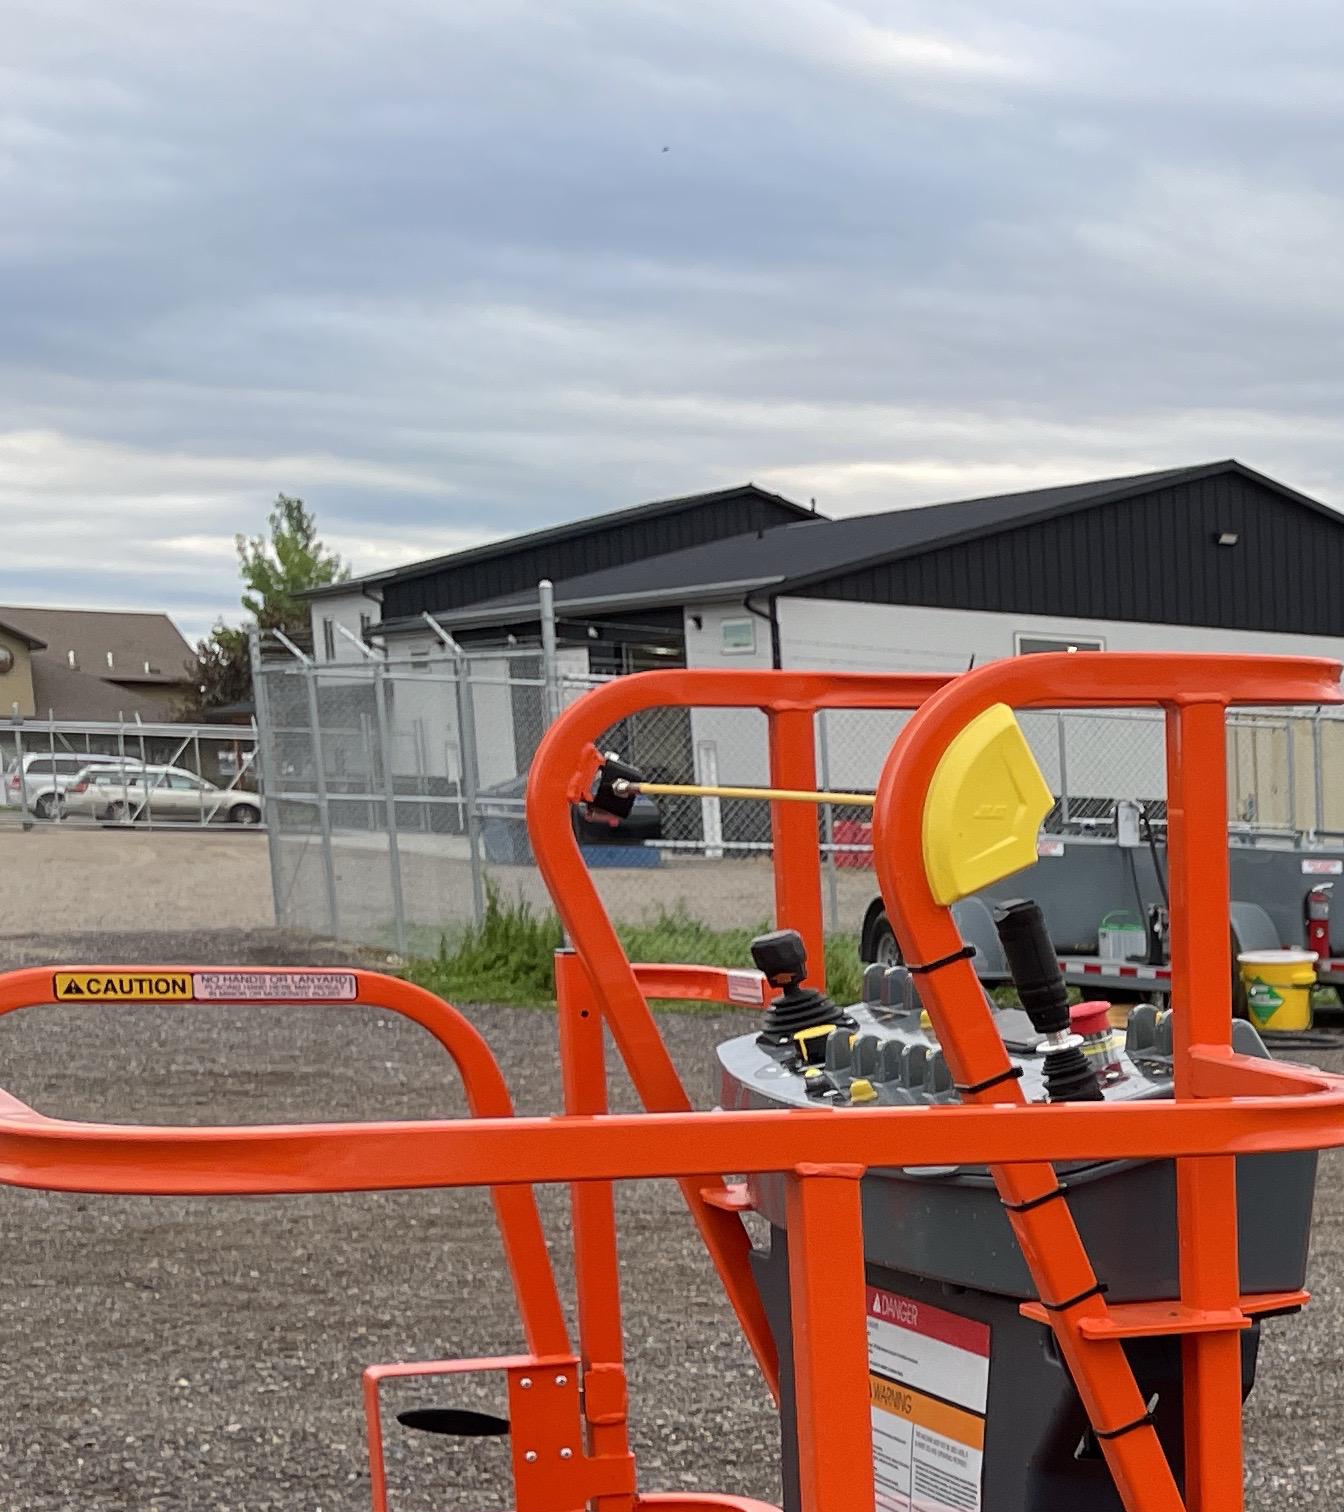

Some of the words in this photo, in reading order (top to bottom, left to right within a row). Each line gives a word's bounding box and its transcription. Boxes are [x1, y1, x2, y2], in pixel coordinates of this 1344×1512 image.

[86, 977, 187, 996] CAUTION
[881, 1294, 919, 1327] DANGER
[872, 1381, 913, 1415] WARNING
